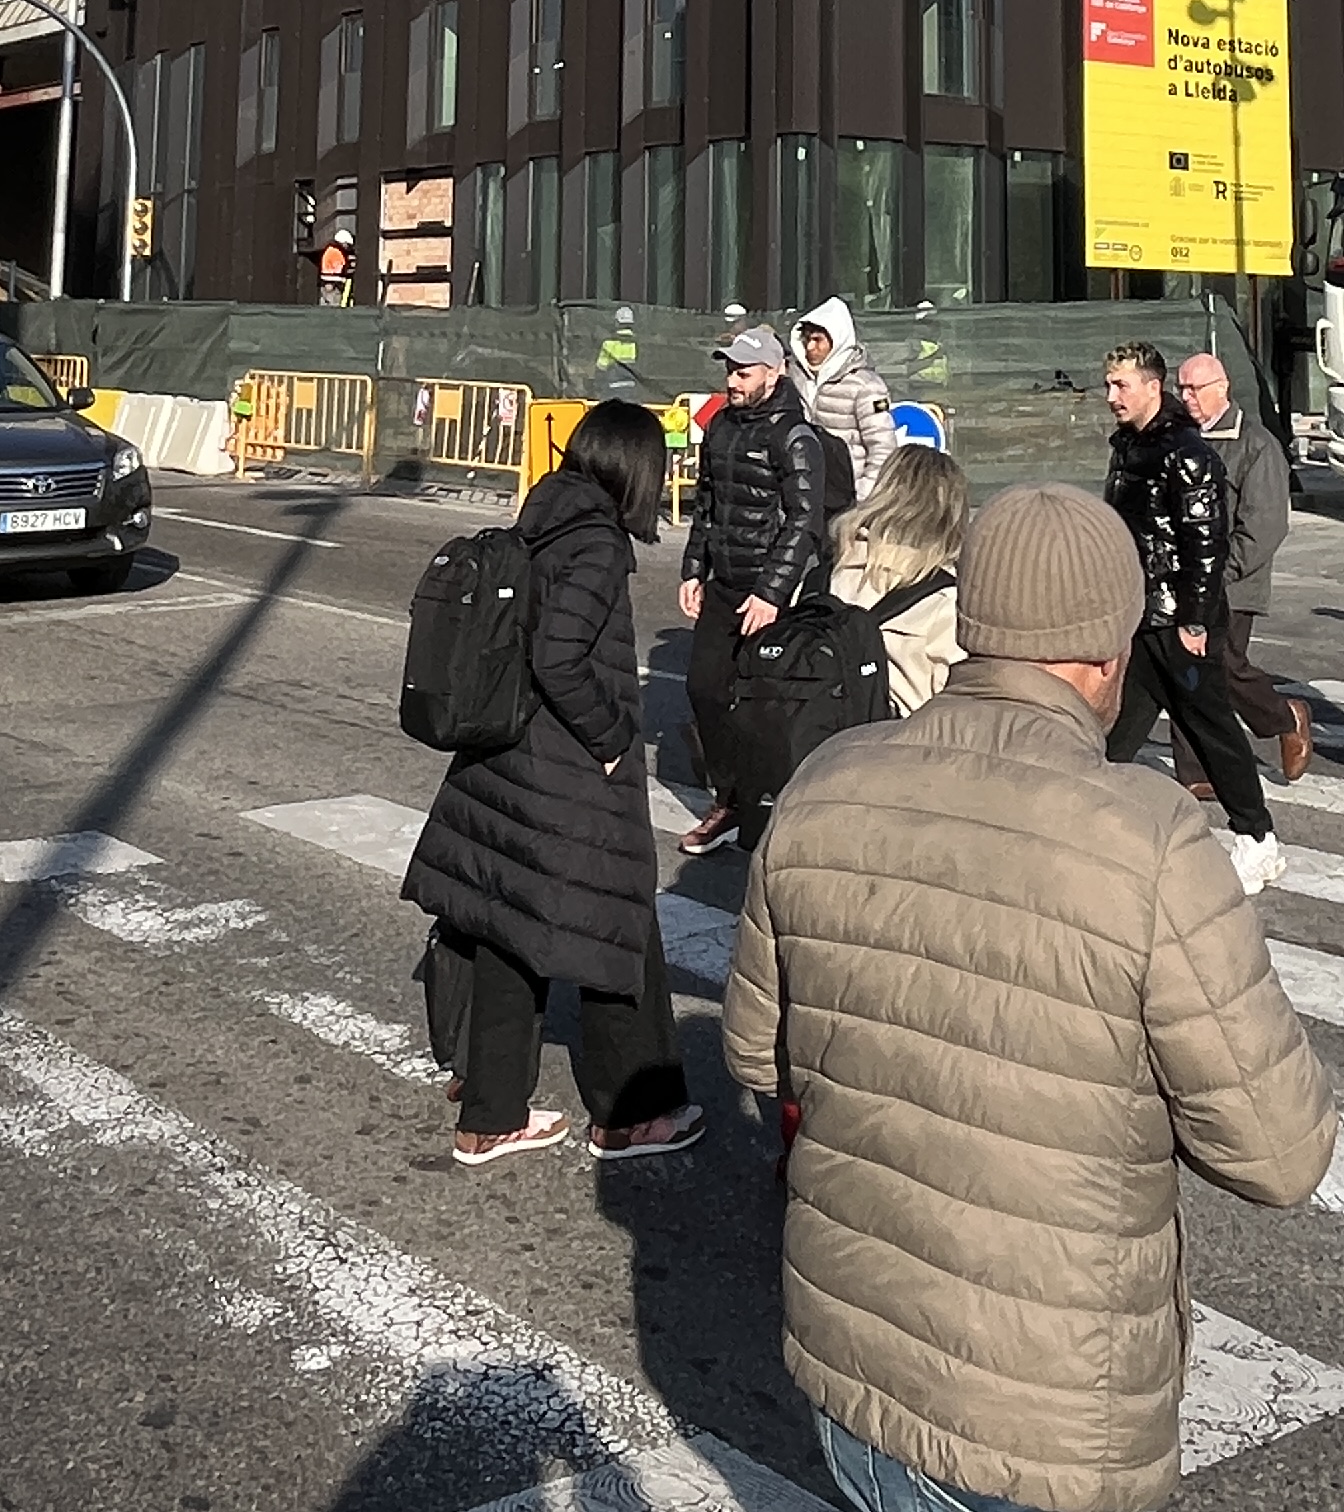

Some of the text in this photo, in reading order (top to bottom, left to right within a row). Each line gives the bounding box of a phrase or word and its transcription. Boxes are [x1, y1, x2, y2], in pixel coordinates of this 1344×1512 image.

[1167, 28, 1210, 49] Nova
[1217, 38, 1279, 57] estació
[1168, 55, 1274, 81] d'autobusos
[1168, 81, 1237, 102] a Lleida
[53, 511, 81, 527] HCV
